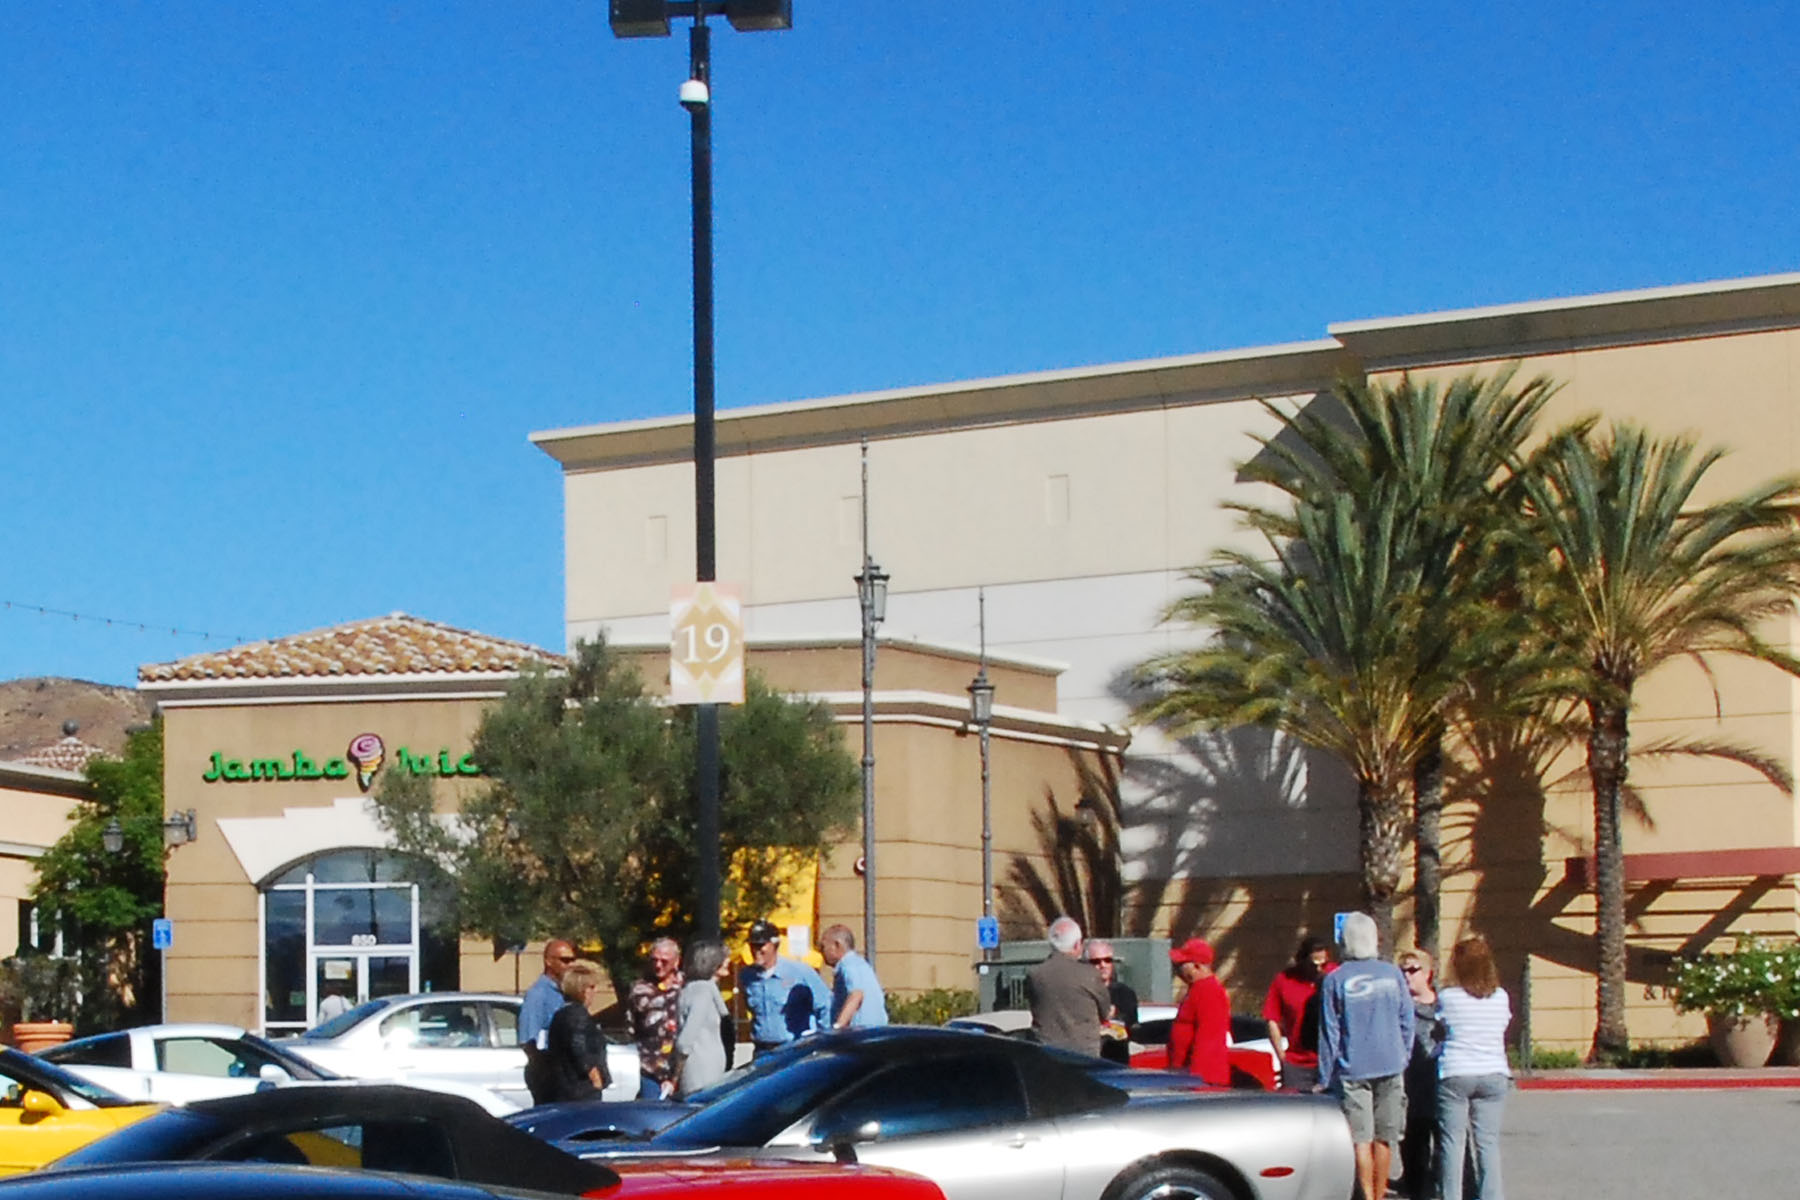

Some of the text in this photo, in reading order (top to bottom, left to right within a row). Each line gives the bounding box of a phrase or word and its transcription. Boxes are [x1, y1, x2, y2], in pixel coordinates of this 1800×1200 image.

[680, 623, 731, 664] 19
[203, 745, 484, 782] Jamba Juic
